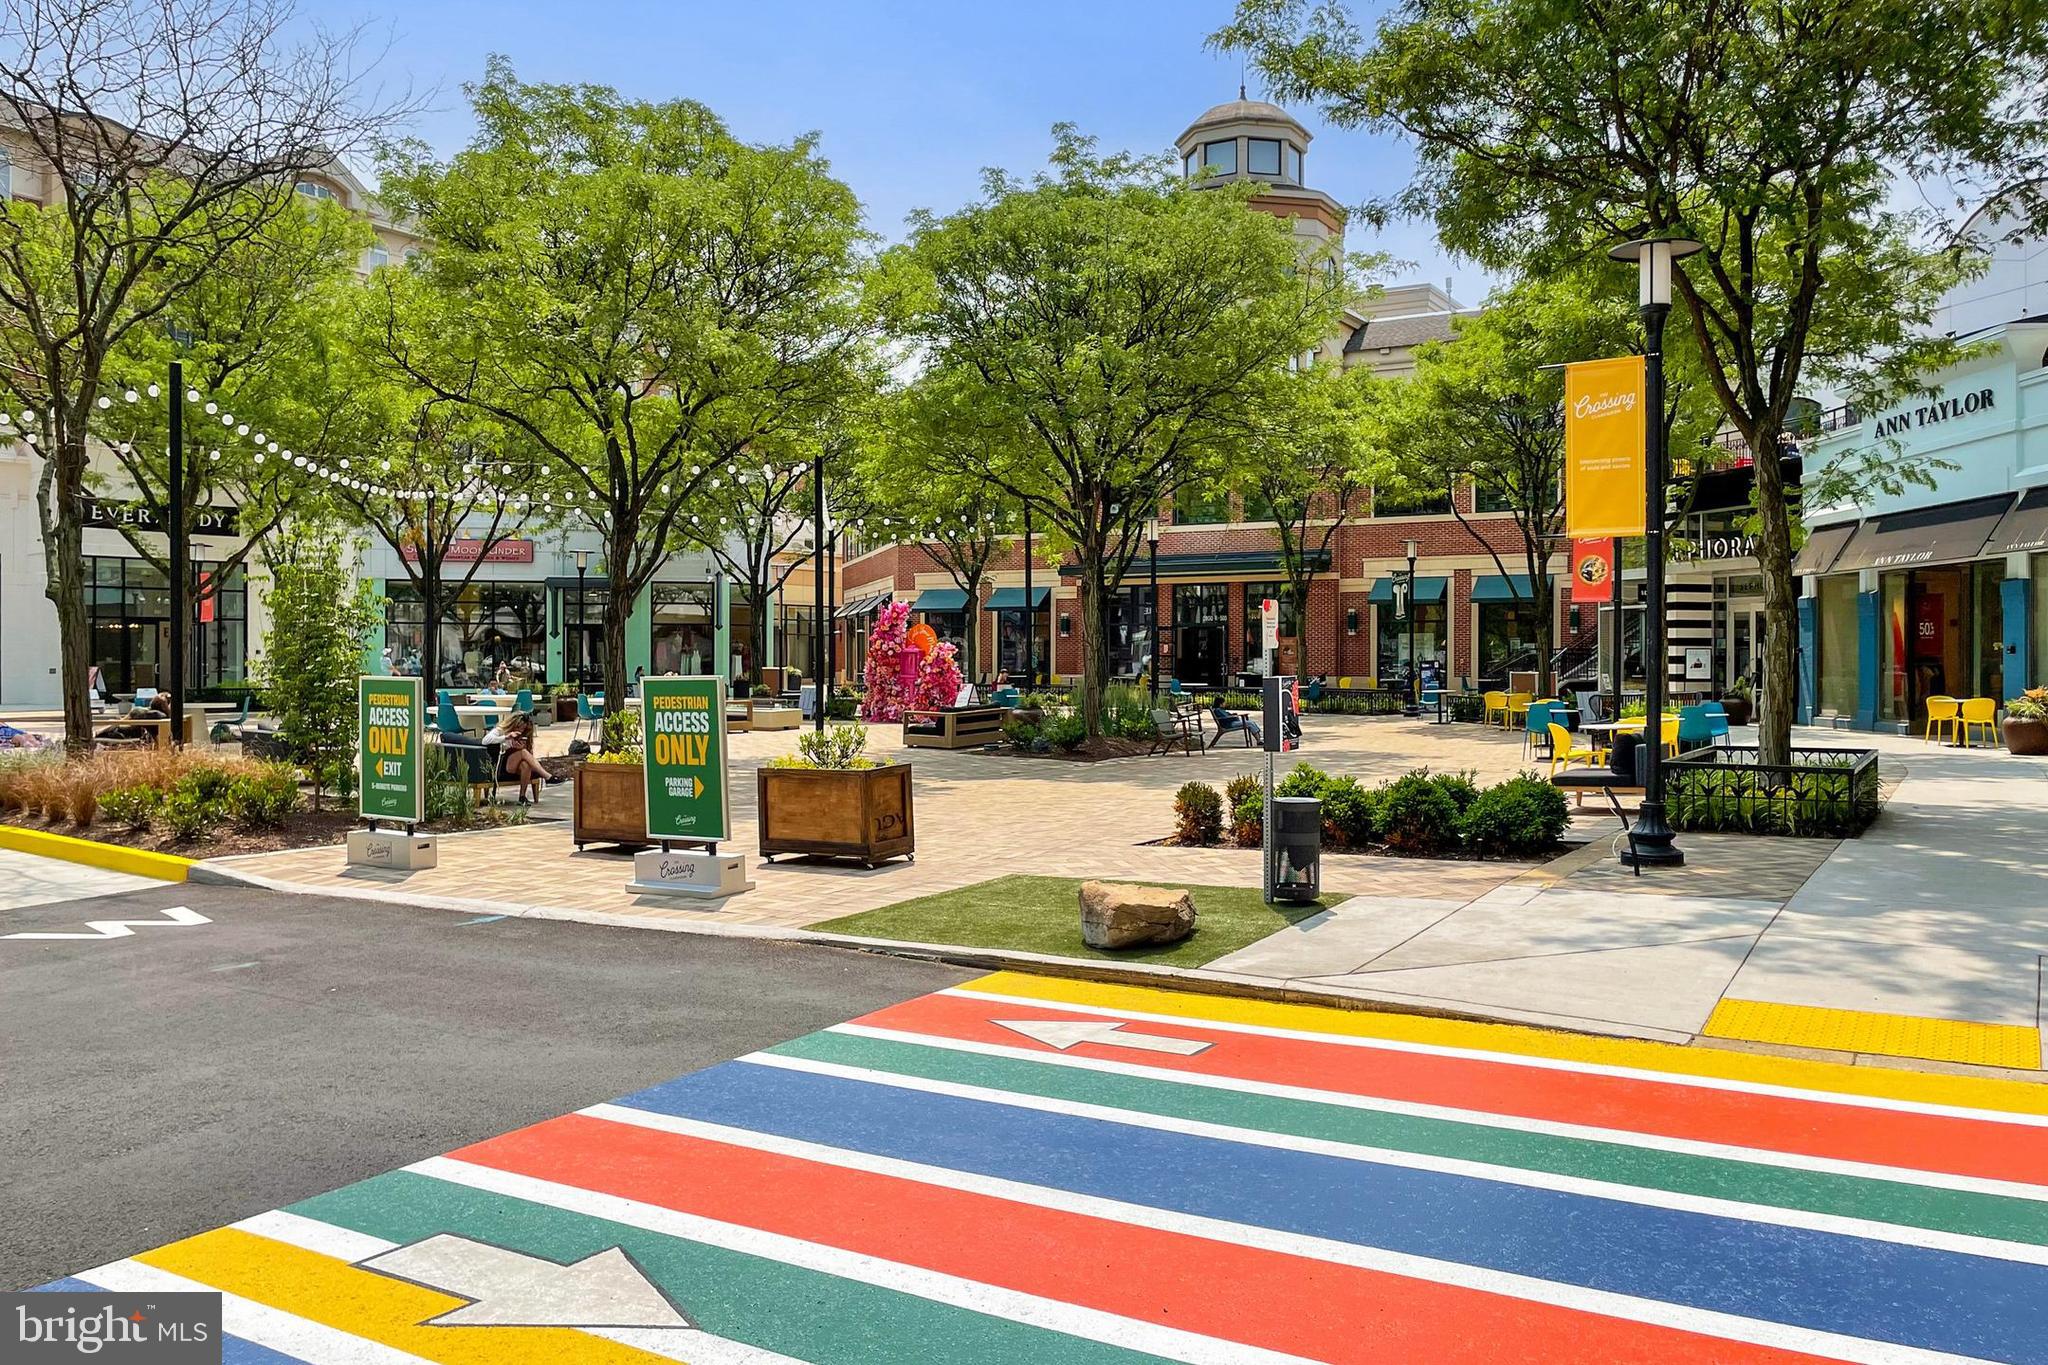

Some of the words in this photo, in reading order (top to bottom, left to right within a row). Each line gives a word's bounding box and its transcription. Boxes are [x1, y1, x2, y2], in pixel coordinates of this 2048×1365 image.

[1574, 392, 1637, 419] Crossing
[1874, 412, 1911, 439] ANN
[1915, 388, 1994, 427] TAYLOR
[1668, 536, 1756, 563] PHORA
[368, 693, 410, 707] PEDESTRIAN
[653, 695, 709, 710] PEDESTRIAN
[369, 707, 410, 727] ACCESS
[654, 711, 710, 733] ACCESS
[368, 726, 410, 755] ONLY
[655, 733, 709, 766] ONLY
[384, 761, 402, 776] EXIT
[664, 776, 693, 788] PARKING
[668, 787, 694, 798] GARAGE
[659, 860, 696, 878] Crossing
